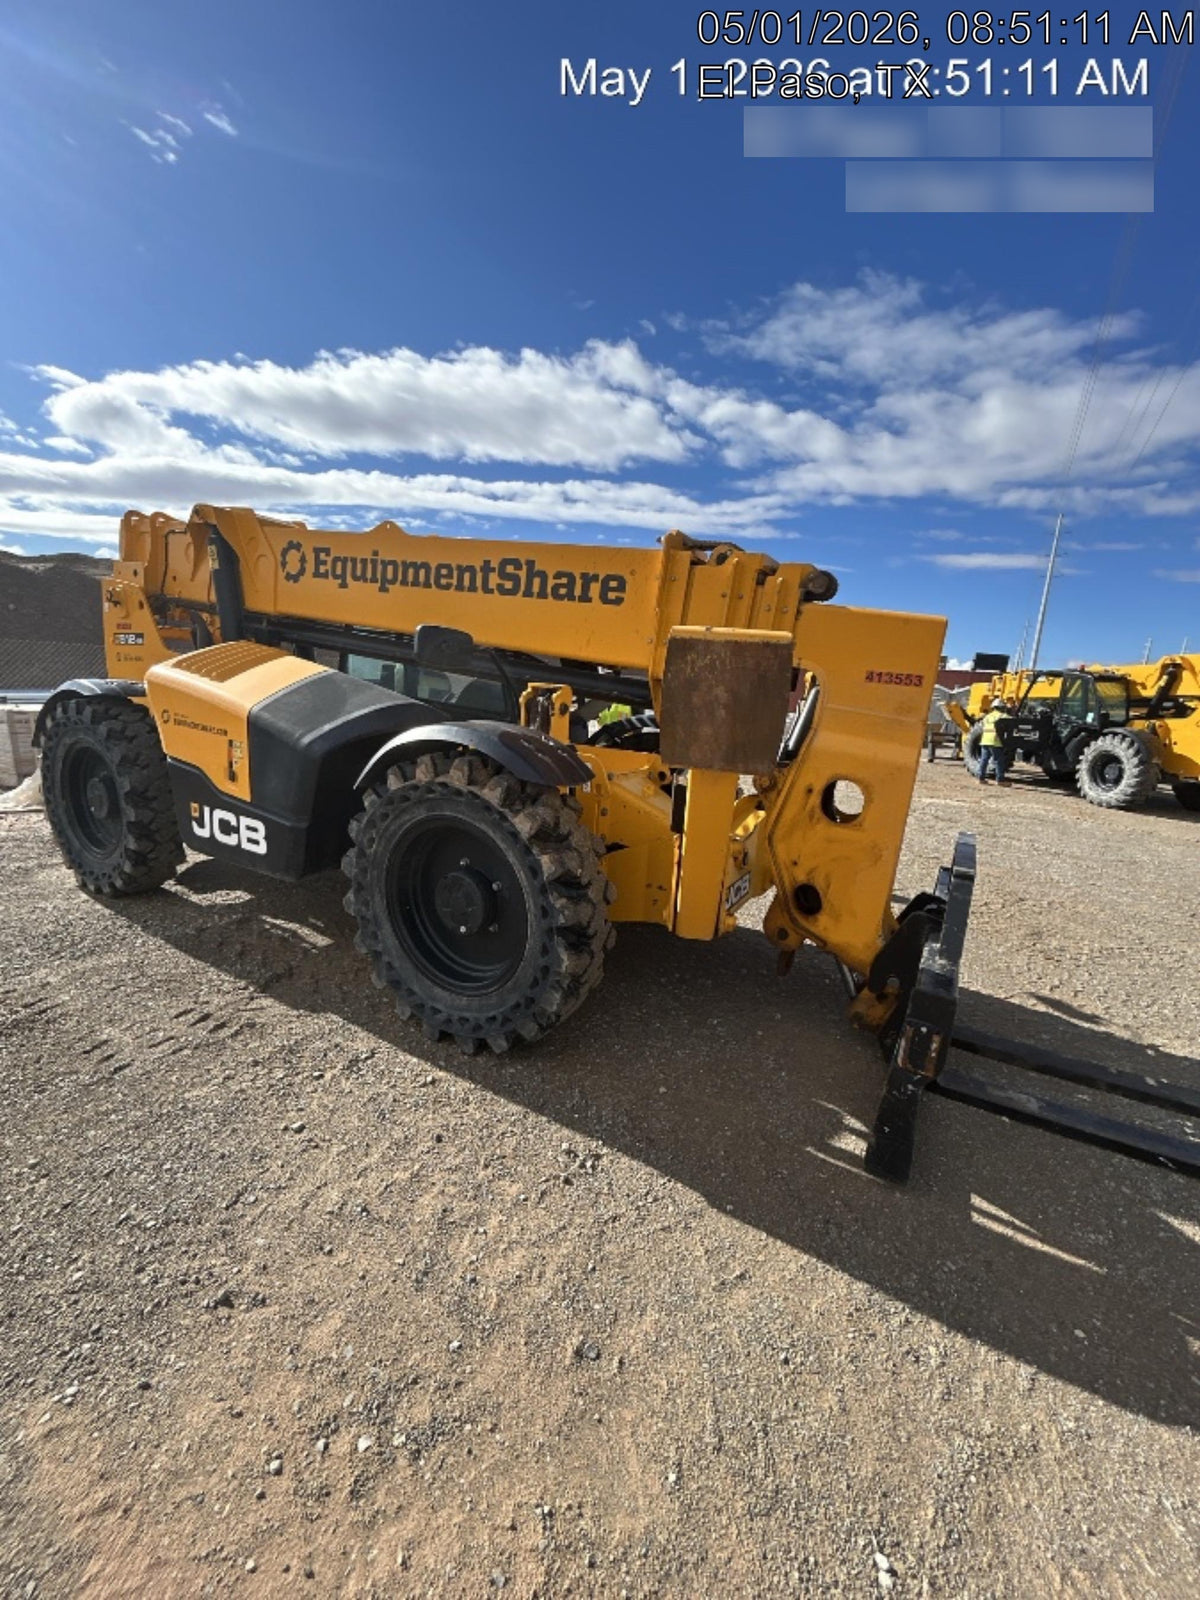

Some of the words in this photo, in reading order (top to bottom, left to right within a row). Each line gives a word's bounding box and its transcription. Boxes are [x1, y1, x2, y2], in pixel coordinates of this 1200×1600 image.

[312, 547, 627, 606] EquipmentShare
[865, 670, 923, 687] 413553
[192, 805, 267, 855] JCB
